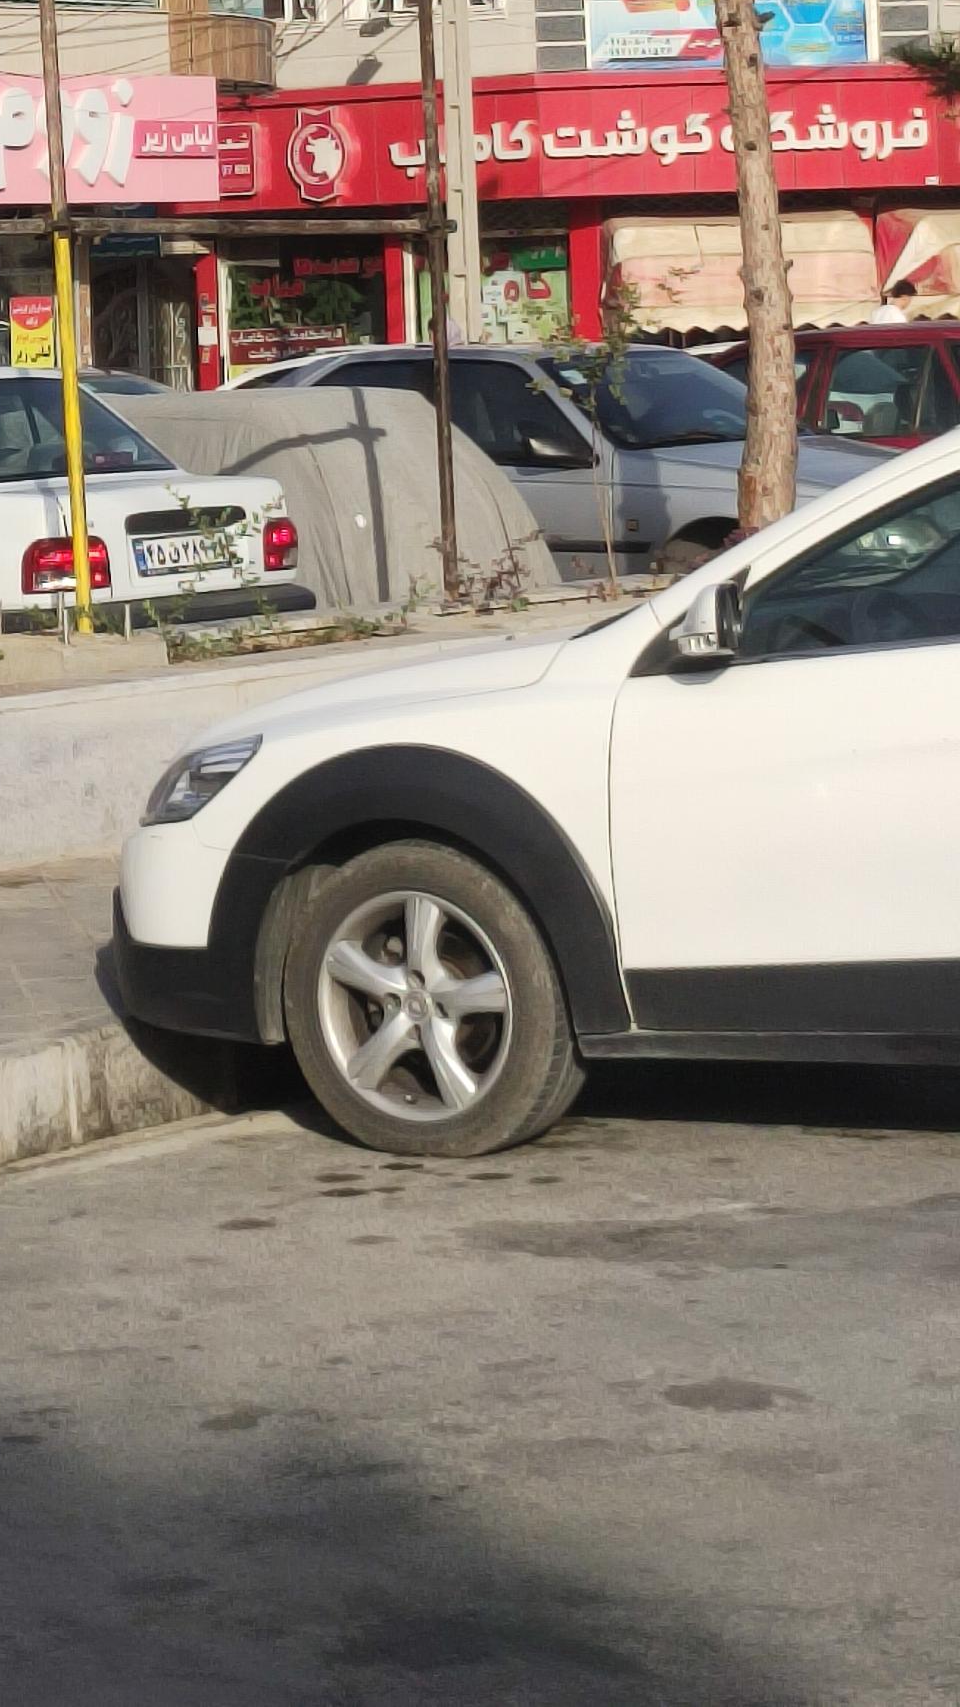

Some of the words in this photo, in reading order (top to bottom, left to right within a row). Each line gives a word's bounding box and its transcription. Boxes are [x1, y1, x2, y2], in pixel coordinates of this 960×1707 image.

[140, 123, 169, 153] زیر
[170, 123, 214, 153] لباس
[388, 119, 539, 178] کامب
[542, 109, 714, 166] گوشت
[719, 103, 929, 161] فروشگه
